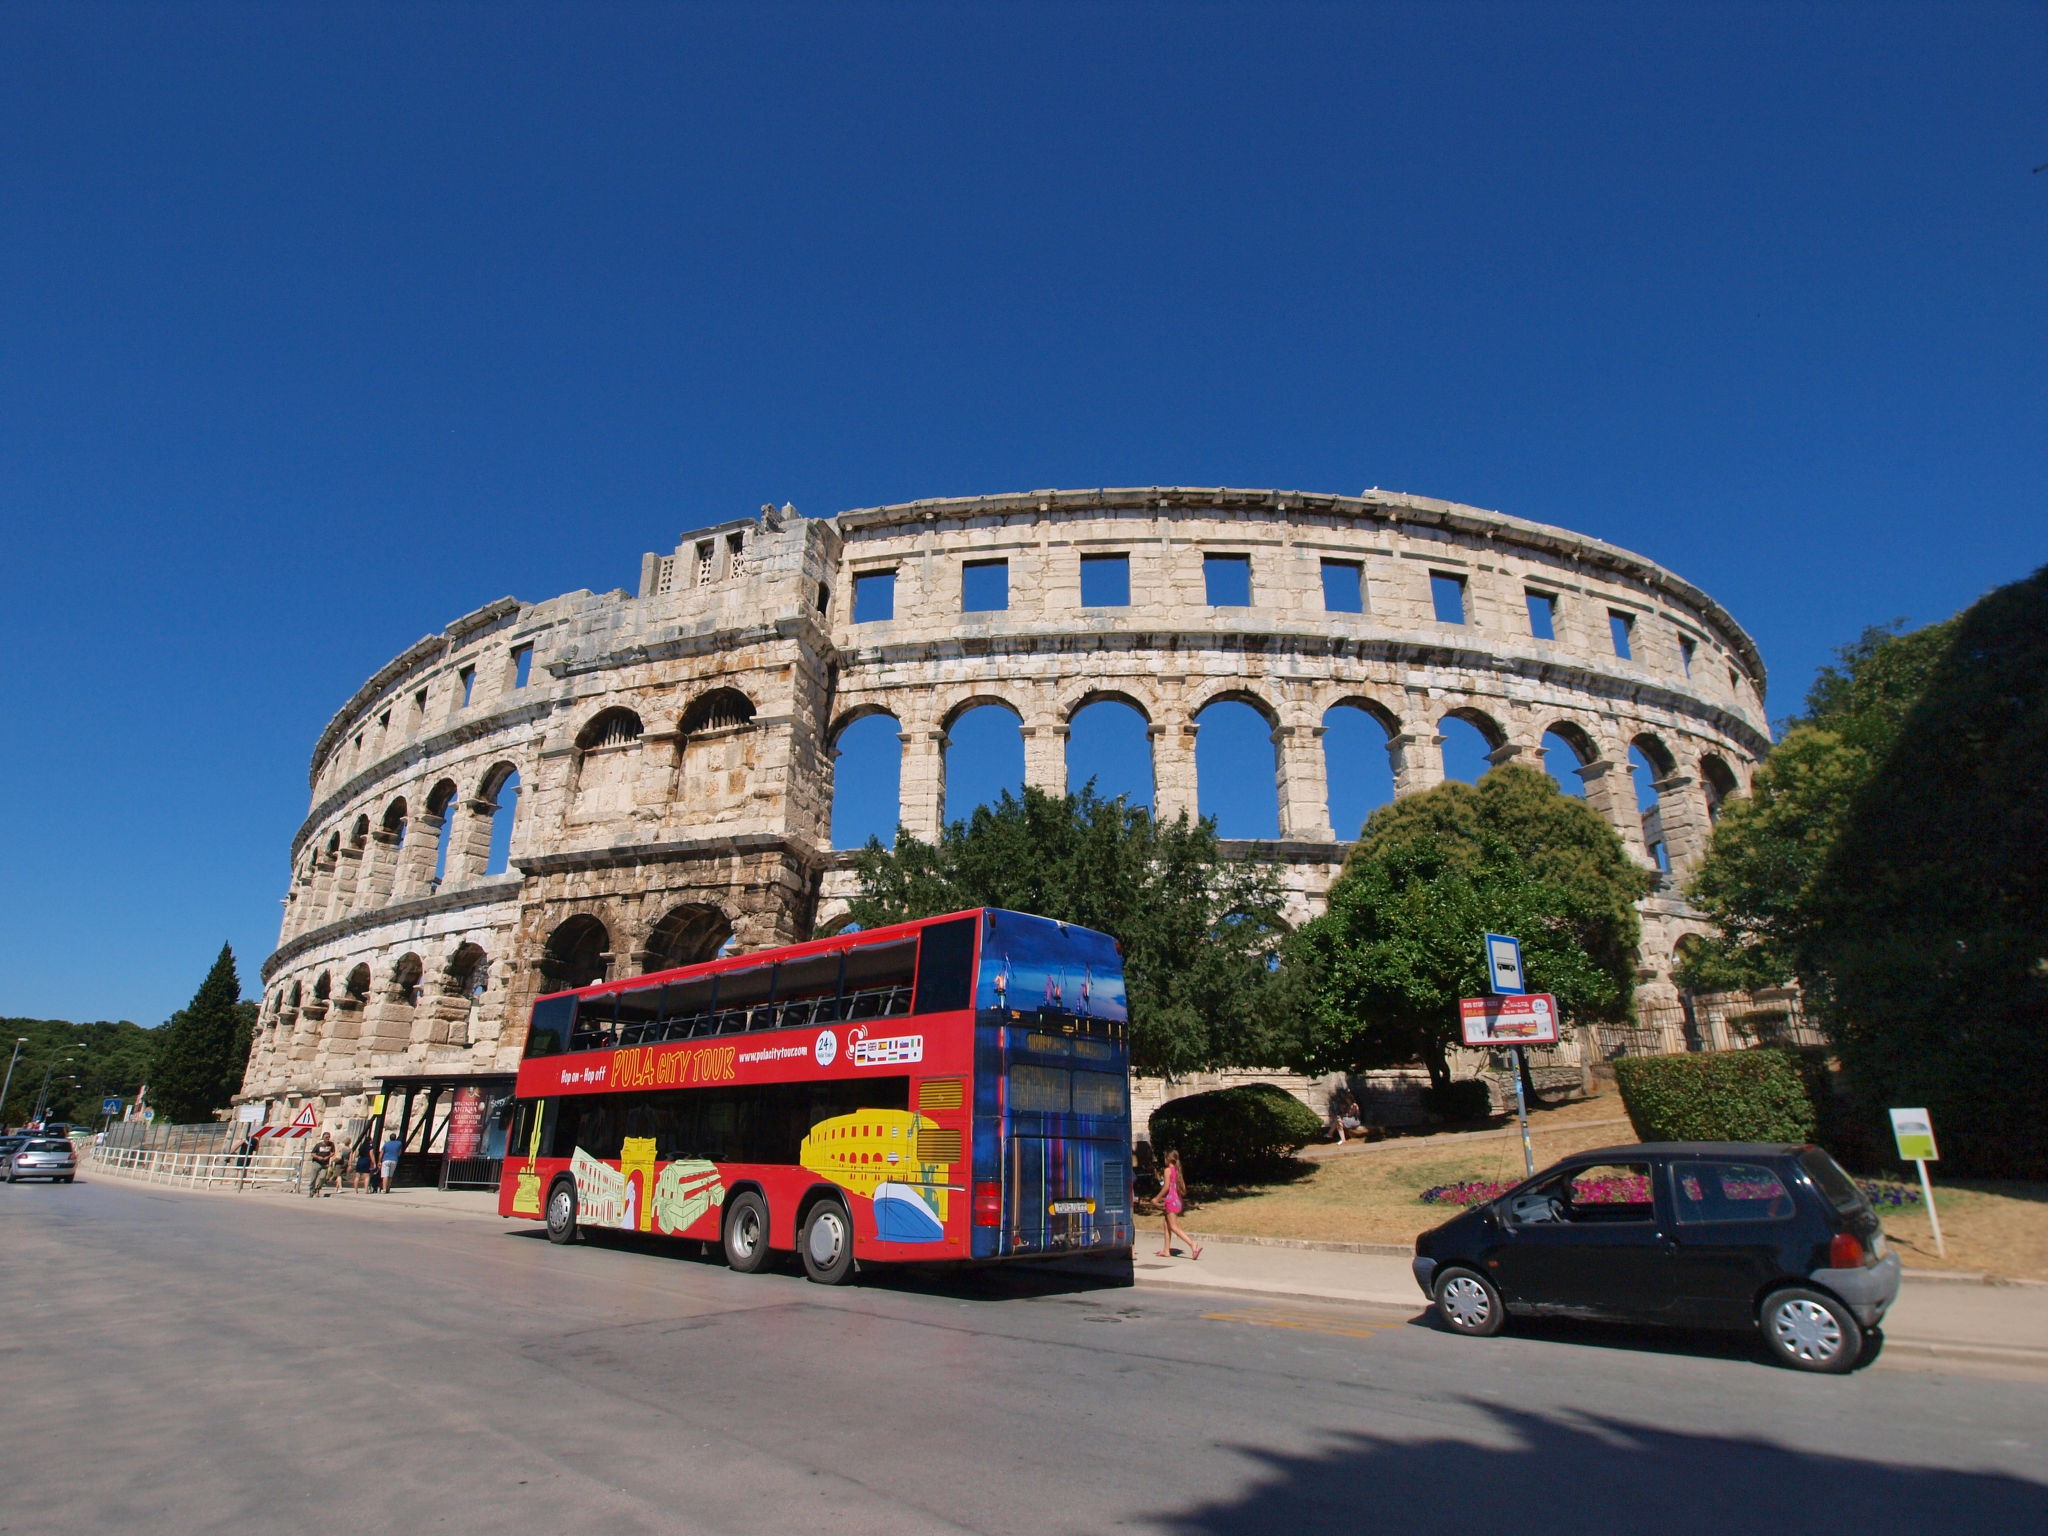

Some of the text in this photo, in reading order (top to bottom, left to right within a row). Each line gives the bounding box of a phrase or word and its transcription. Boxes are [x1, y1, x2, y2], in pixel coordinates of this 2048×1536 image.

[561, 1069, 572, 1085] Hop
[571, 1072, 579, 1083] on
[583, 1067, 595, 1085] Hop
[595, 1065, 606, 1081] off
[610, 1046, 736, 1088] PULA CITY TOUR
